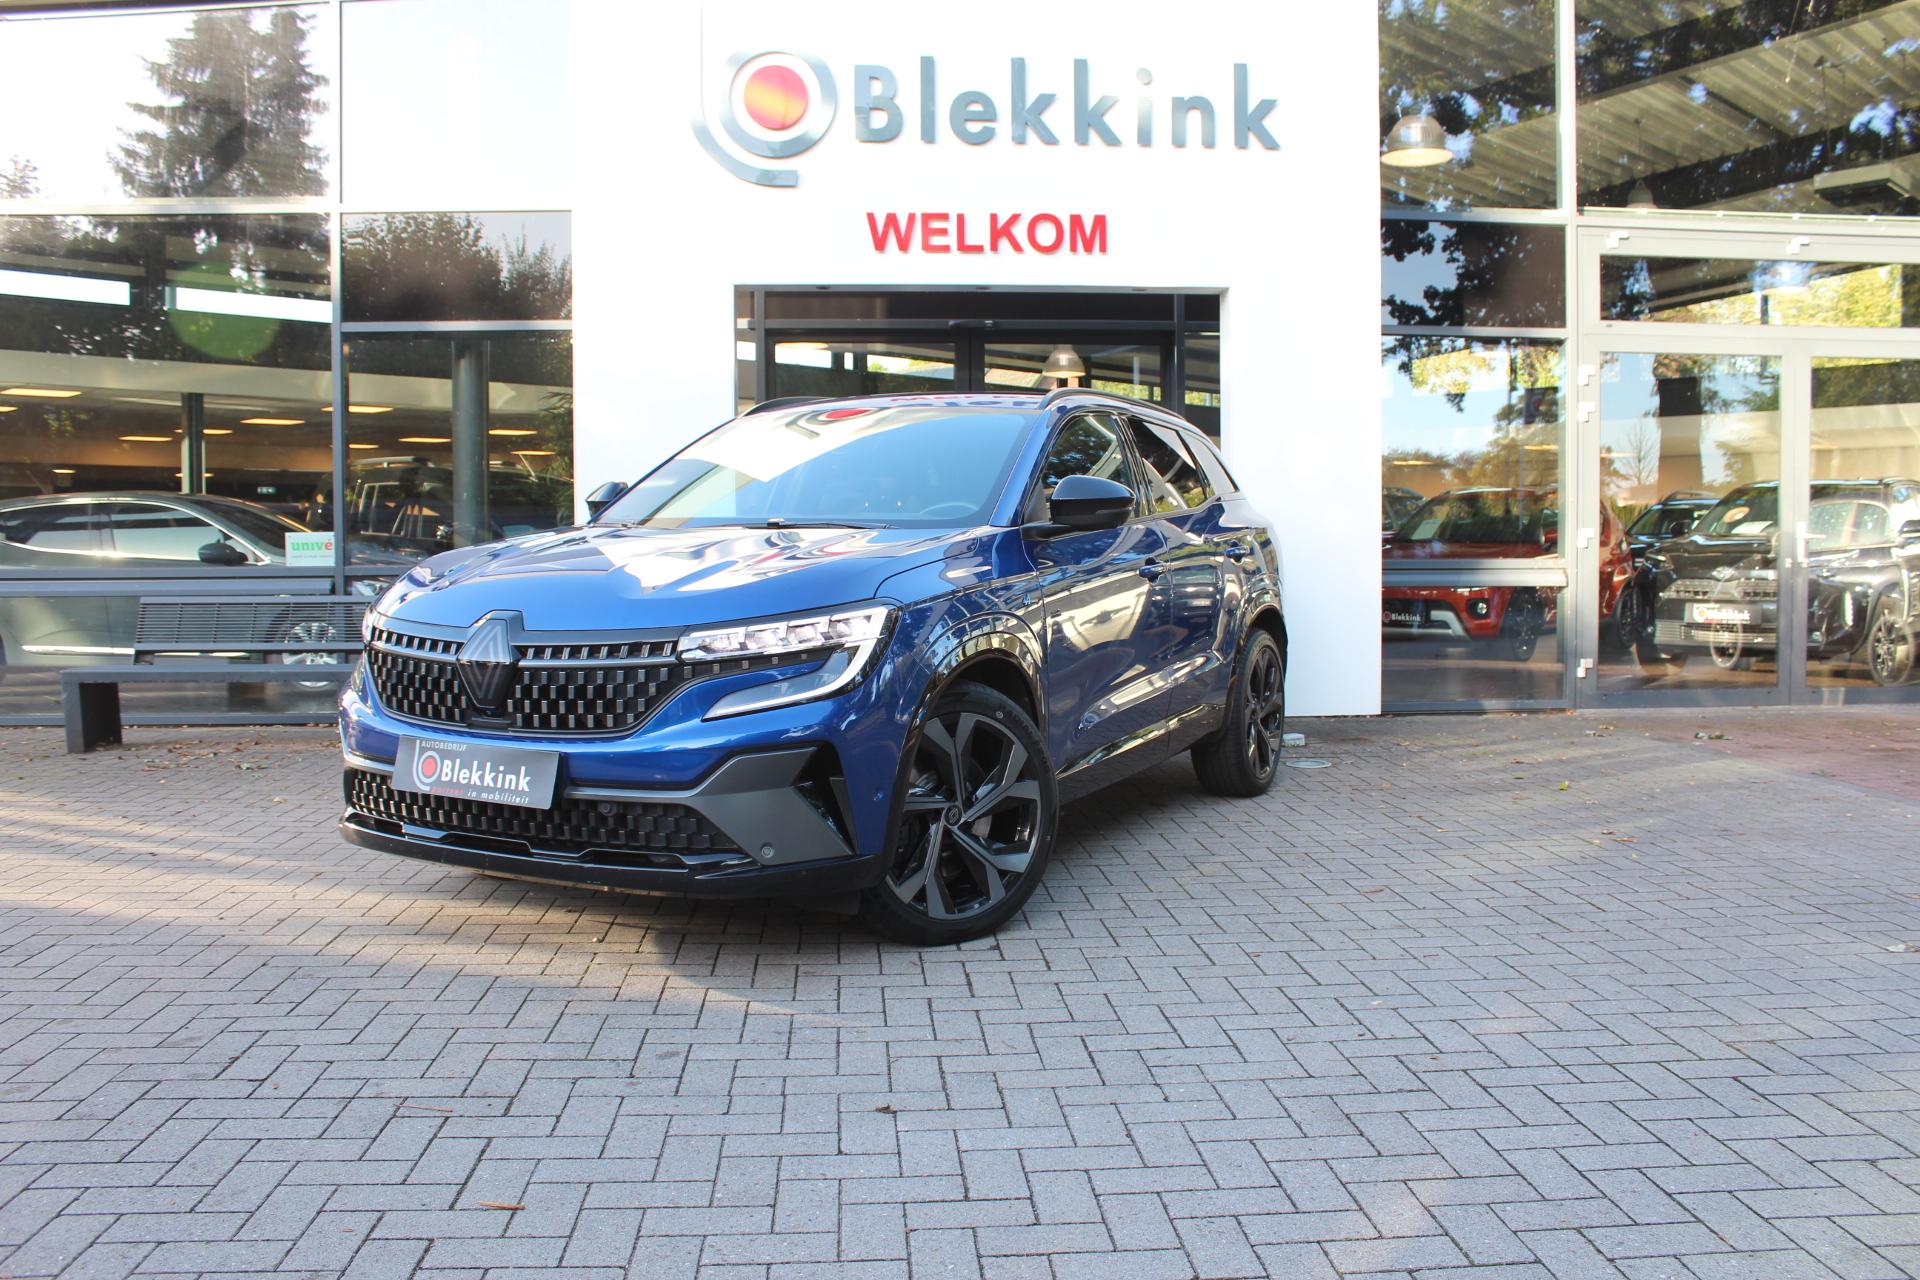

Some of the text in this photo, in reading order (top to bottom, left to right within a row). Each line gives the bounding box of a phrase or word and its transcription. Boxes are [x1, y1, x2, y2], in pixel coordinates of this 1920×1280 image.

[854, 56, 1280, 150] Blekkink
[866, 212, 1108, 254] WELKOM
[421, 740, 467, 751] AUTOBEDRIJF
[440, 758, 531, 792] Blekkink
[467, 789, 477, 798] in
[481, 790, 529, 804] mobiliteit
